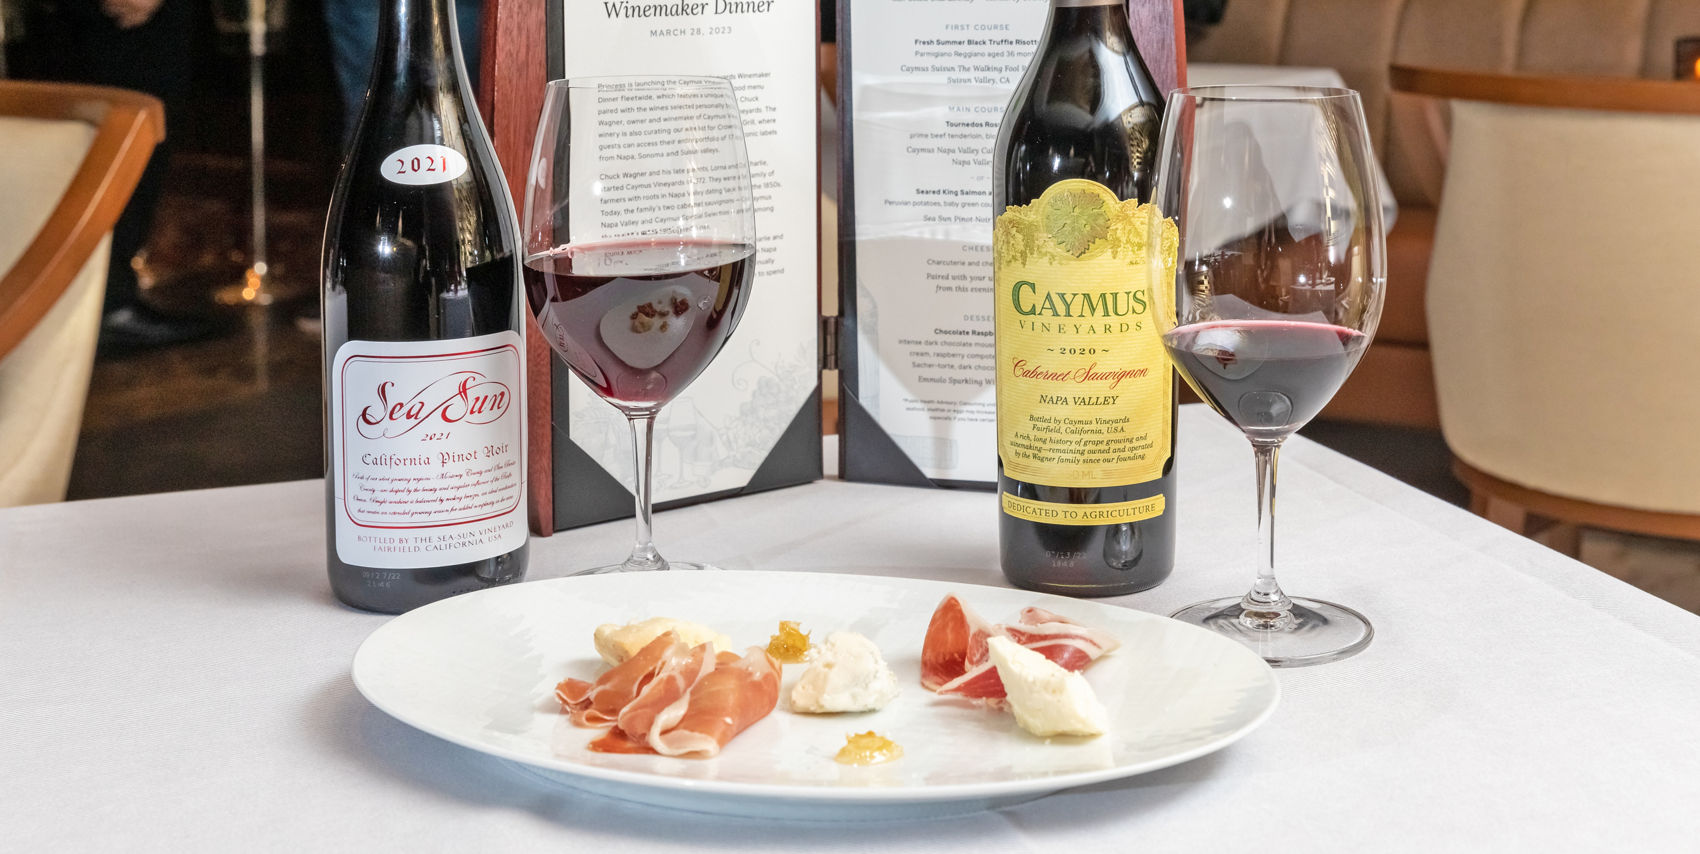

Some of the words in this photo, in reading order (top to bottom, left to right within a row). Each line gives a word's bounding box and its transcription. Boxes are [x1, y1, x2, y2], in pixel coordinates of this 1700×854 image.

[604, 0, 708, 19] Winemaker
[714, 0, 774, 15] Dinner
[650, 29, 686, 37] MARCH
[690, 28, 705, 36] 28,
[709, 26, 732, 35] 2023
[915, 51, 952, 59] Parmigiano
[954, 51, 985, 59] Reggiano
[901, 65, 929, 73] Caymus
[973, 65, 1003, 73] Walking
[974, 77, 998, 85] Valley,
[906, 146, 935, 156] Caymus
[936, 147, 956, 155] Napa
[958, 147, 979, 155] Valley
[396, 155, 447, 175] 2021
[952, 159, 971, 167] Napa
[943, 200, 959, 208] baby
[936, 284, 953, 293] from
[934, 328, 970, 336] Chocolate
[1019, 319, 1142, 334] VINEYARDS
[933, 351, 965, 359] raspberry
[1012, 357, 1073, 382] Cabernet
[1074, 362, 1149, 390] Sauvignon
[948, 377, 984, 386] Sparkling
[361, 380, 425, 426] Sea
[440, 375, 507, 424] Sun
[1039, 394, 1068, 406] NAPA
[1073, 395, 1119, 406] VALLEY
[1029, 415, 1052, 424] Bottled
[1053, 417, 1063, 425] by
[1063, 418, 1093, 426] Caymus
[1095, 416, 1130, 425] Vineyards
[1032, 424, 1063, 435] Fairfield,
[1064, 426, 1105, 436] California,
[420, 431, 451, 442] 2021
[1019, 432, 1032, 441] rich,
[1033, 435, 1048, 444] long
[1049, 436, 1073, 445] history
[1074, 438, 1083, 446] of
[1083, 439, 1105, 447] grape
[1106, 437, 1134, 445] growing
[1135, 433, 1148, 441] and
[1087, 447, 1108, 455] owned
[1127, 442, 1154, 453] operated
[361, 453, 431, 469] California
[439, 449, 478, 468] Pinot
[483, 443, 509, 458] Noir
[1021, 451, 1031, 459] the
[1032, 453, 1055, 463] Wagner
[1057, 455, 1081, 465] family
[1116, 452, 1146, 464] founding
[1007, 500, 1059, 518] DEDICATED
[1062, 510, 1078, 519] TO
[1081, 503, 1156, 519] AGRICULTURE
[357, 535, 395, 544] BOTTLED
[398, 537, 409, 545] BY
[414, 536, 434, 544] THE
[478, 520, 514, 536] VINEYARD
